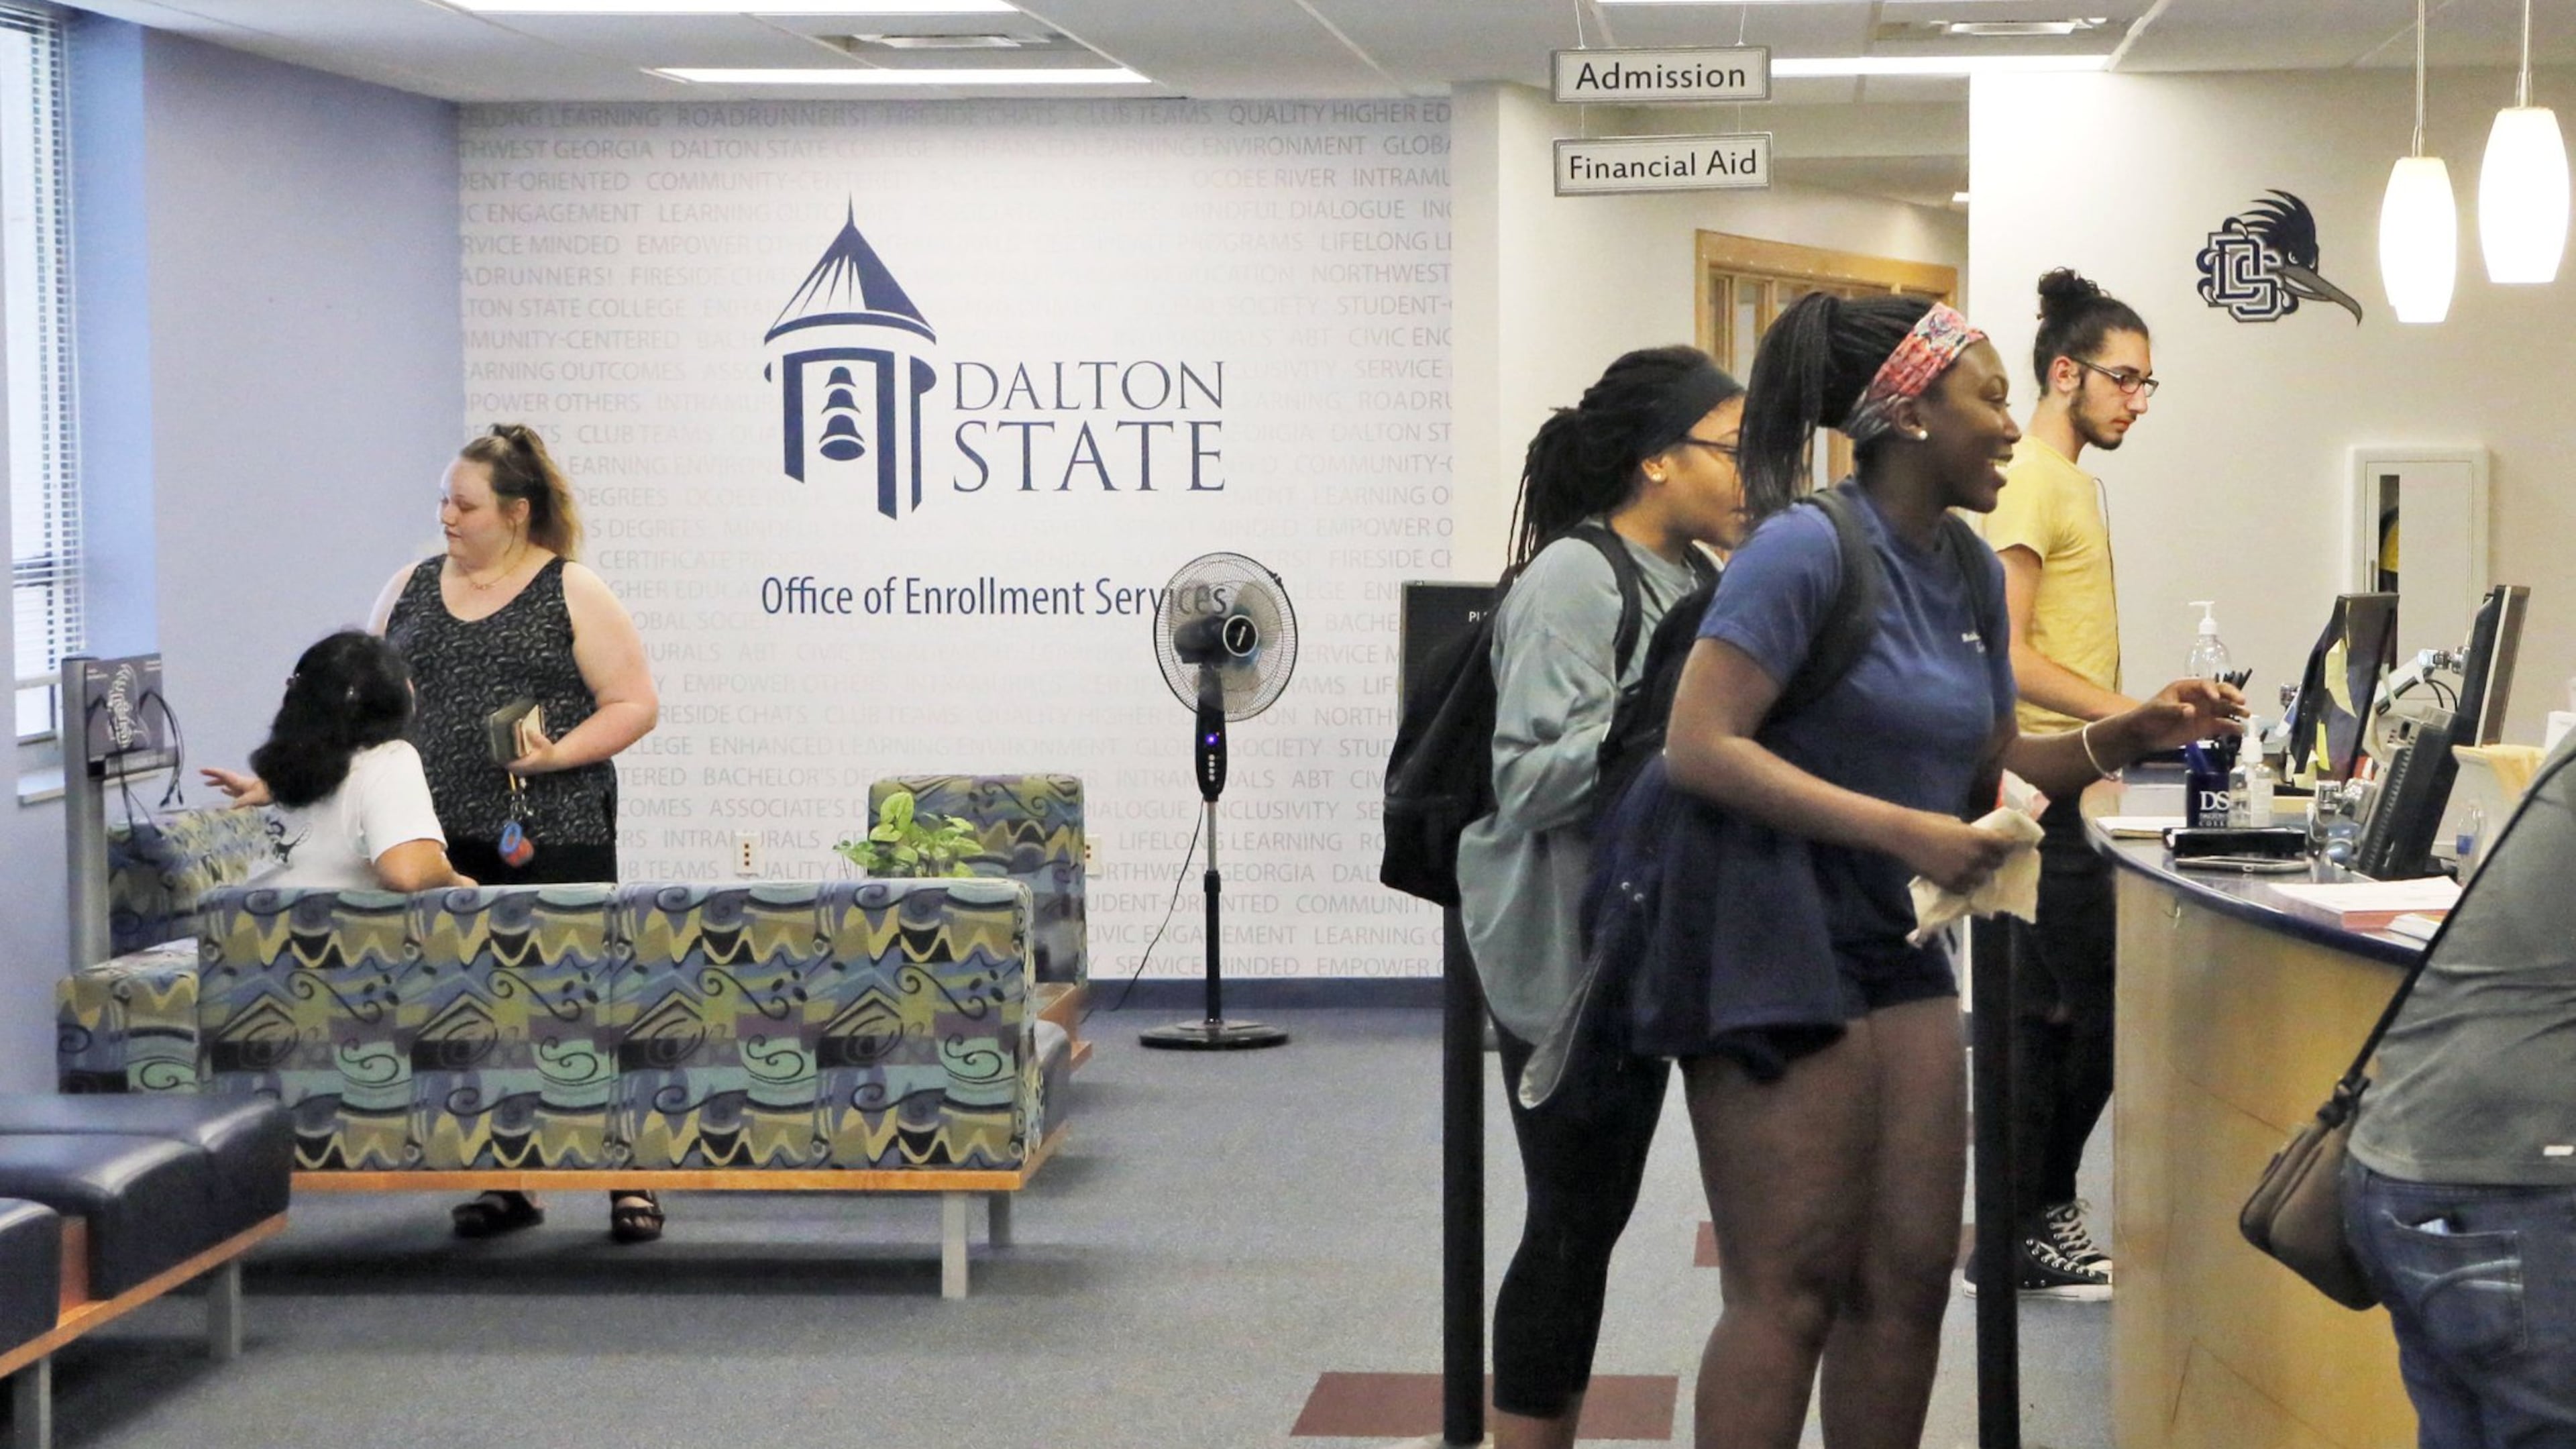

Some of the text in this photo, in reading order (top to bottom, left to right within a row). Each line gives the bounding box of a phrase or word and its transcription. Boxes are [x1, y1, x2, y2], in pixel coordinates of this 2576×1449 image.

[1576, 62, 1746, 90] Admission
[1228, 103, 1326, 125] QUALITY
[1332, 102, 1417, 123] HIGHER
[553, 140, 651, 160] GEORGIA
[672, 140, 759, 160] DALTON
[766, 139, 832, 158] STATE
[1203, 136, 1366, 156] ENVIRONMENT
[1570, 148, 1757, 180] Financial Aid
[1191, 168, 1267, 189] OCOEE
[1275, 168, 1337, 188] RIVER
[487, 203, 641, 223] ENGAGEMENT
[659, 203, 770, 223] LEARNING
[1289, 199, 1407, 220] DIALOGUE
[529, 235, 620, 254] MINDED
[637, 235, 751, 254] EMPOWER
[1320, 231, 1428, 252] LIFELONG
[631, 266, 722, 286] FIRESIDE
[1311, 263, 1452, 284] NORTHWEST
[520, 298, 580, 318] STATE
[588, 298, 685, 318] COLLEGE
[1227, 296, 1319, 316] SOCIETY
[1337, 295, 1452, 315] STUDENT-
[1288, 327, 1332, 347] ABT
[1347, 327, 1404, 347] CIVIC
[561, 362, 686, 381] OUTCOMES
[1354, 359, 1443, 378] SERVICE
[953, 360, 1226, 411] DALTON
[555, 393, 641, 413] OTHERS
[577, 424, 634, 444] CLUB
[639, 424, 714, 444] TEAMS
[1331, 423, 1421, 443] DALTON
[953, 420, 1226, 492] STATE
[1313, 486, 1426, 506] LEARNING
[608, 518, 706, 537] DEGREES
[1316, 517, 1431, 537] EMPOWER
[598, 550, 733, 570] CERTIFICATE
[1328, 549, 1425, 570] FIRESIDE
[761, 576, 1228, 616] Office of Enrollment Services
[738, 643, 777, 662] ABT
[683, 675, 796, 694] EMPOWER
[804, 674, 890, 694] OTHERS
[738, 705, 808, 724] CHATS
[888, 705, 960, 724] TEAMS
[709, 737, 833, 756] ENHANCED
[839, 737, 943, 757] LEARNING
[1229, 738, 1324, 757] SOCIETY
[703, 767, 838, 787] BACHELOR'S
[1291, 769, 1334, 789] ABT
[709, 798, 845, 818] ASSOCIATE'S
[1216, 800, 1339, 820] NCLUSIVITY
[2200, 790, 2229, 810] DS
[1232, 831, 1342, 851] LEARNING
[648, 861, 719, 880] TEAMS
[1142, 925, 1297, 945] ENGAEMENT
[1314, 925, 1426, 945] LEARNING
[1116, 956, 1200, 977] SERVICE
[1316, 956, 1431, 976] EMPOWER
